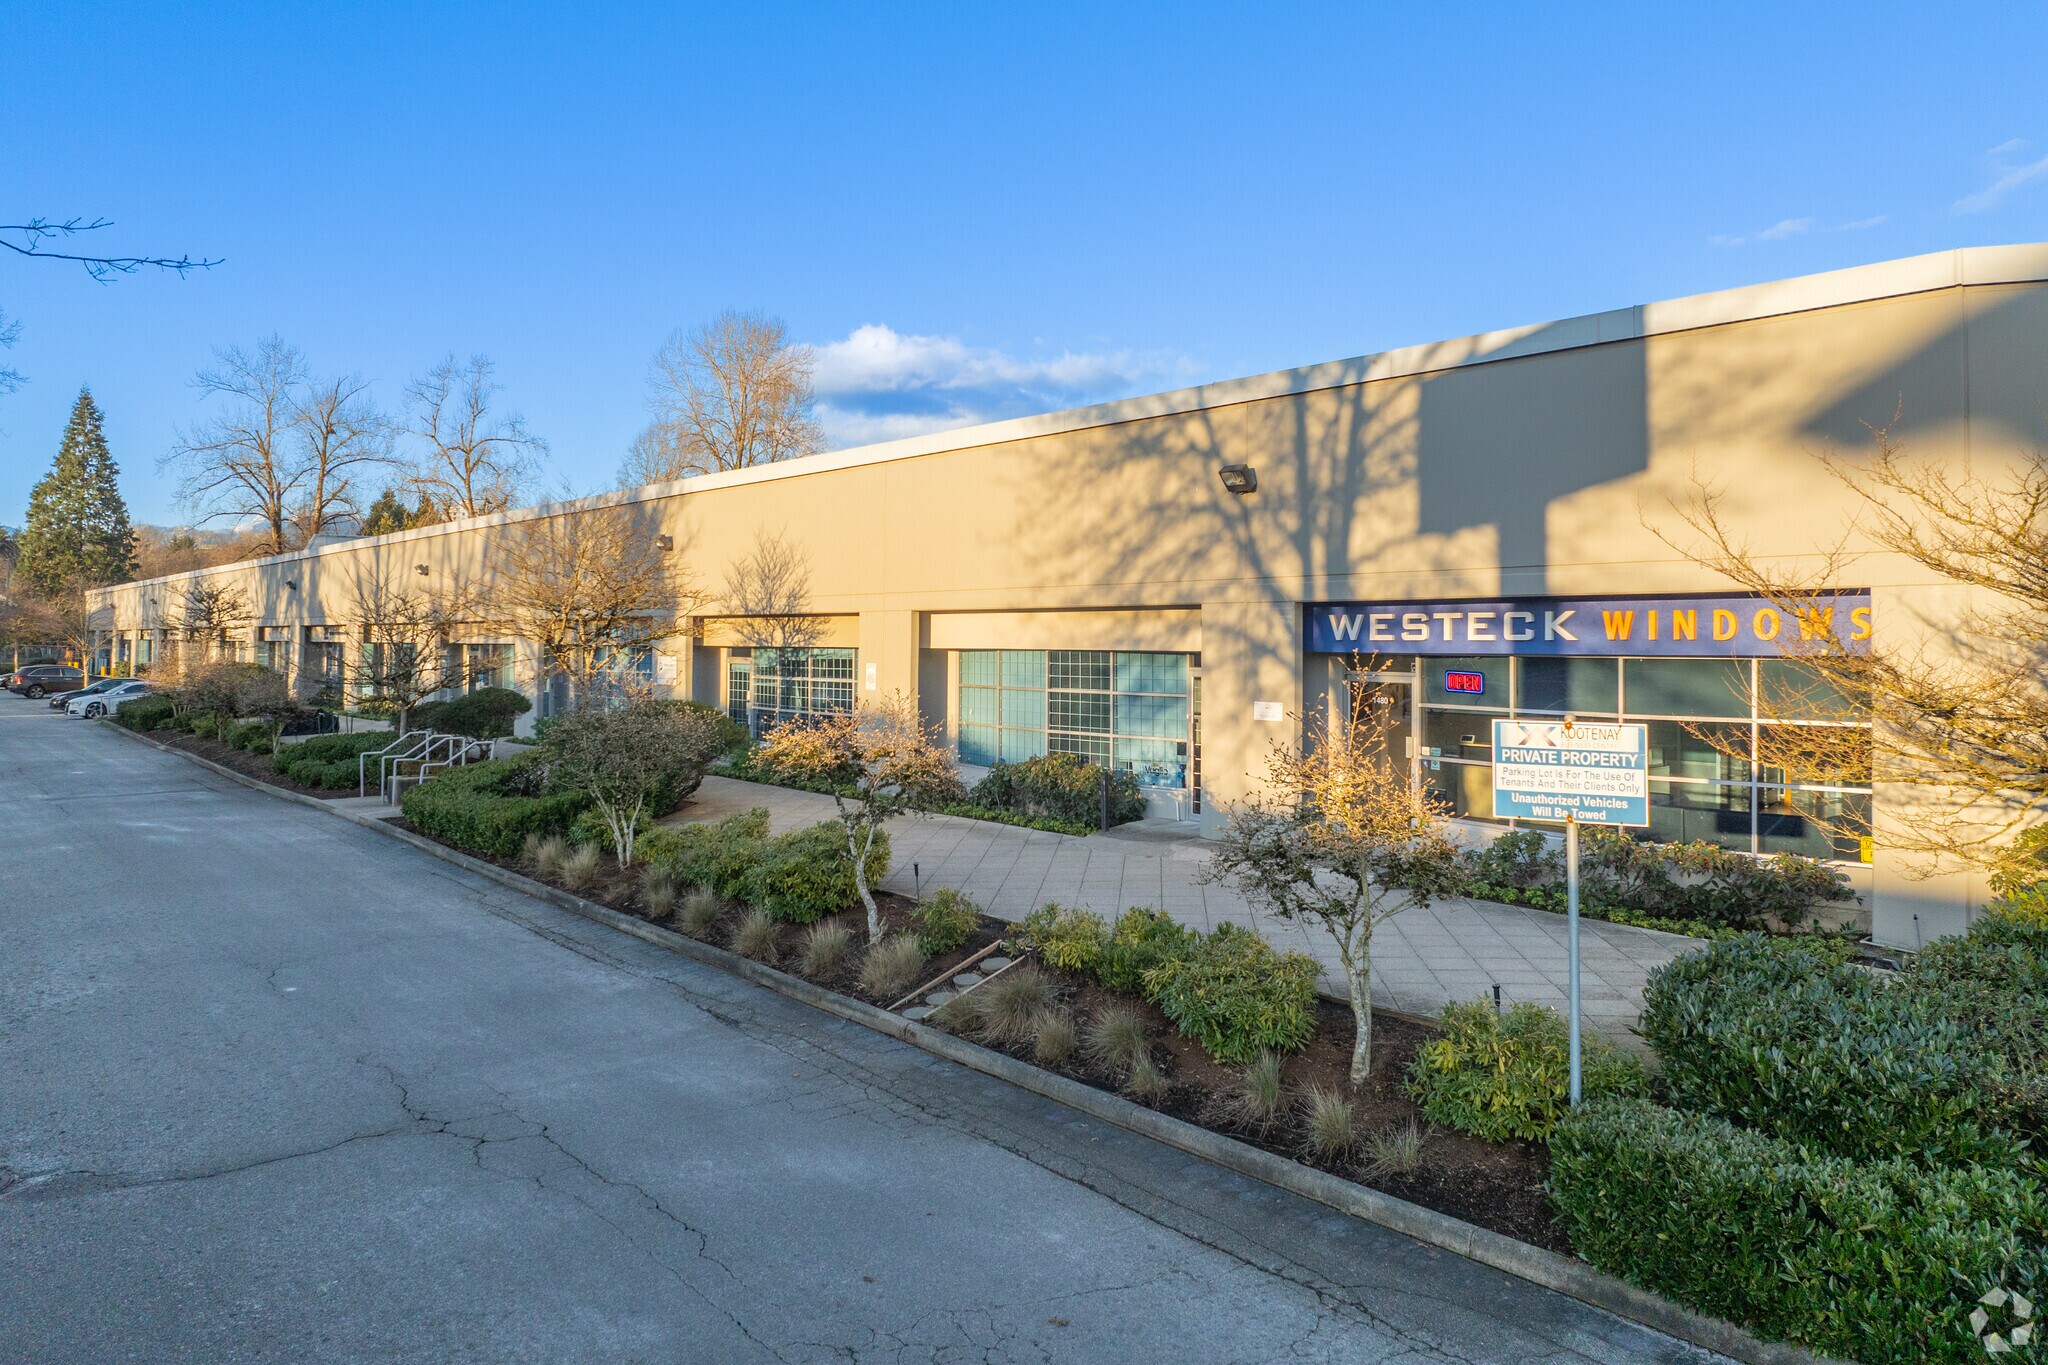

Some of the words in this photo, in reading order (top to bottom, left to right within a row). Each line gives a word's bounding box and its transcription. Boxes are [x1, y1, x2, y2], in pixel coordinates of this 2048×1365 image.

[1328, 610, 1579, 641] WESTECK
[1602, 607, 1872, 641] WINDOWS
[1448, 674, 1480, 690] OPEN
[1560, 727, 1621, 740] KOOTENAY
[1502, 749, 1558, 764] PRIVATE
[1561, 751, 1638, 767] PROPERTY
[1503, 767, 1535, 779] Parking
[1539, 769, 1553, 777] Lot
[1555, 770, 1563, 778] Is
[1566, 770, 1581, 779] For
[1584, 771, 1600, 780] The
[1604, 772, 1621, 781] Use
[1624, 773, 1635, 781] Of
[1501, 777, 1535, 787] Tenants
[1538, 780, 1555, 788] And
[1559, 780, 1581, 789] Their
[1584, 782, 1616, 792] Clients
[1619, 783, 1640, 795] Only
[1511, 792, 1580, 806] Unauthorized
[1582, 797, 1629, 809] Vehicles
[1532, 806, 1552, 817] Will
[1555, 808, 1569, 817] Be
[1571, 808, 1606, 820] Towed
